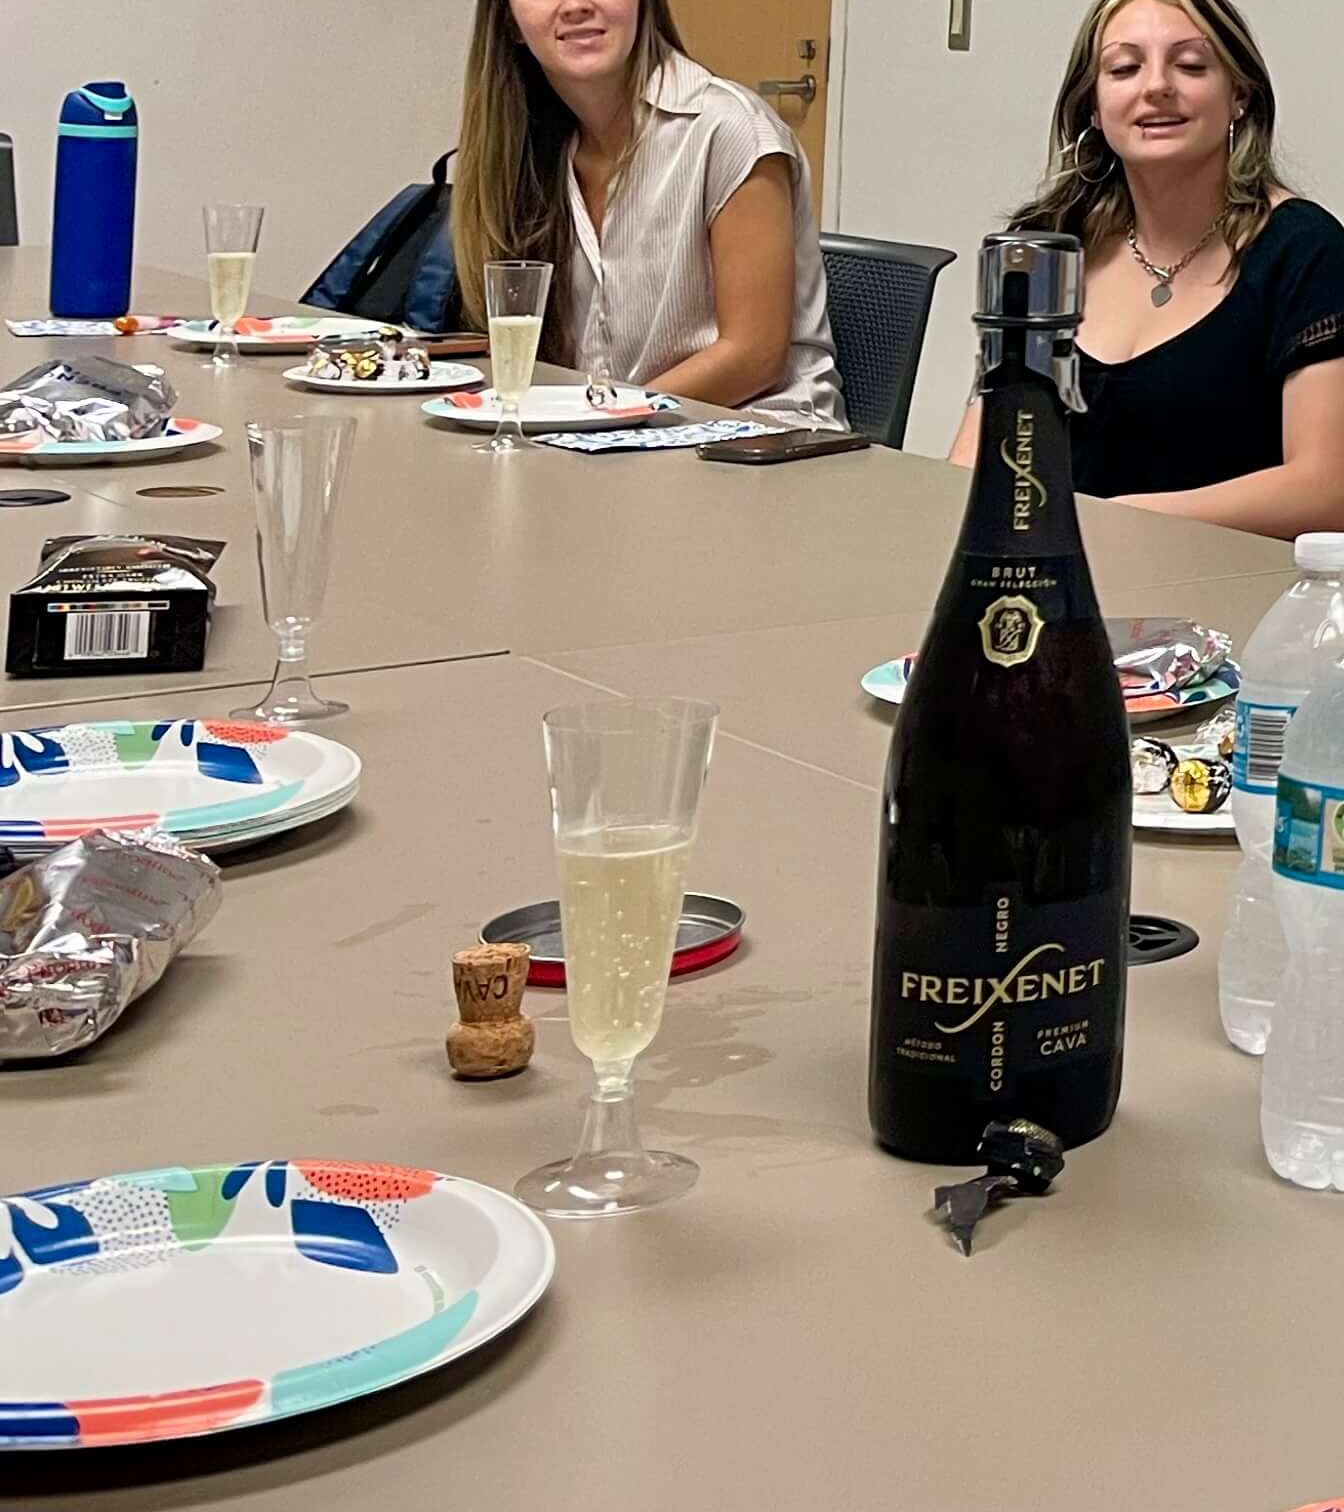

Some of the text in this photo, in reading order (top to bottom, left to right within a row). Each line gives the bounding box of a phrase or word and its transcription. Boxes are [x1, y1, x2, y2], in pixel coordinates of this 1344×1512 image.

[1005, 408, 1042, 531] FREIXENET
[991, 566, 1037, 579] BRUT
[995, 896, 1010, 953] NEGRO
[900, 948, 1105, 1026] FREIXENET
[990, 1021, 1008, 1092] CORDON
[1039, 1033, 1088, 1057] CAVA
